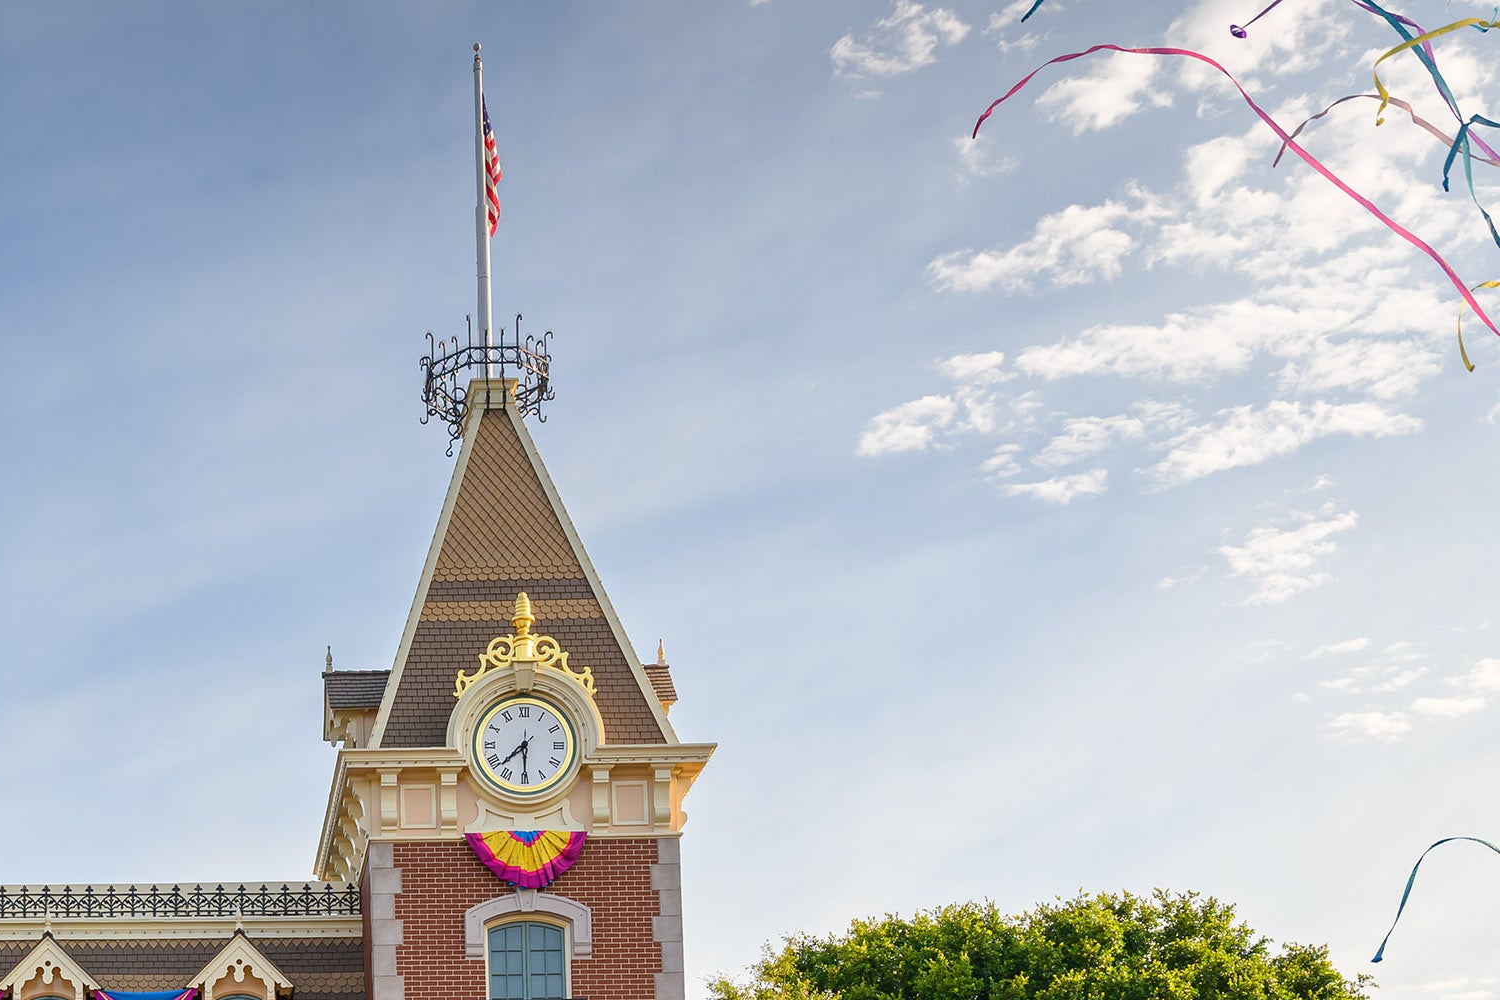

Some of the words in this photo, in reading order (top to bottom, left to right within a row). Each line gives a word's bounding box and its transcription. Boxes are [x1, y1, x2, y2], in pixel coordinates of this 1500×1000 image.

[501, 710, 513, 723] XI
[518, 706, 530, 718] XII
[489, 724, 500, 734] X
[548, 724, 560, 734] II
[485, 741, 496, 749] IX
[553, 741, 565, 750] III
